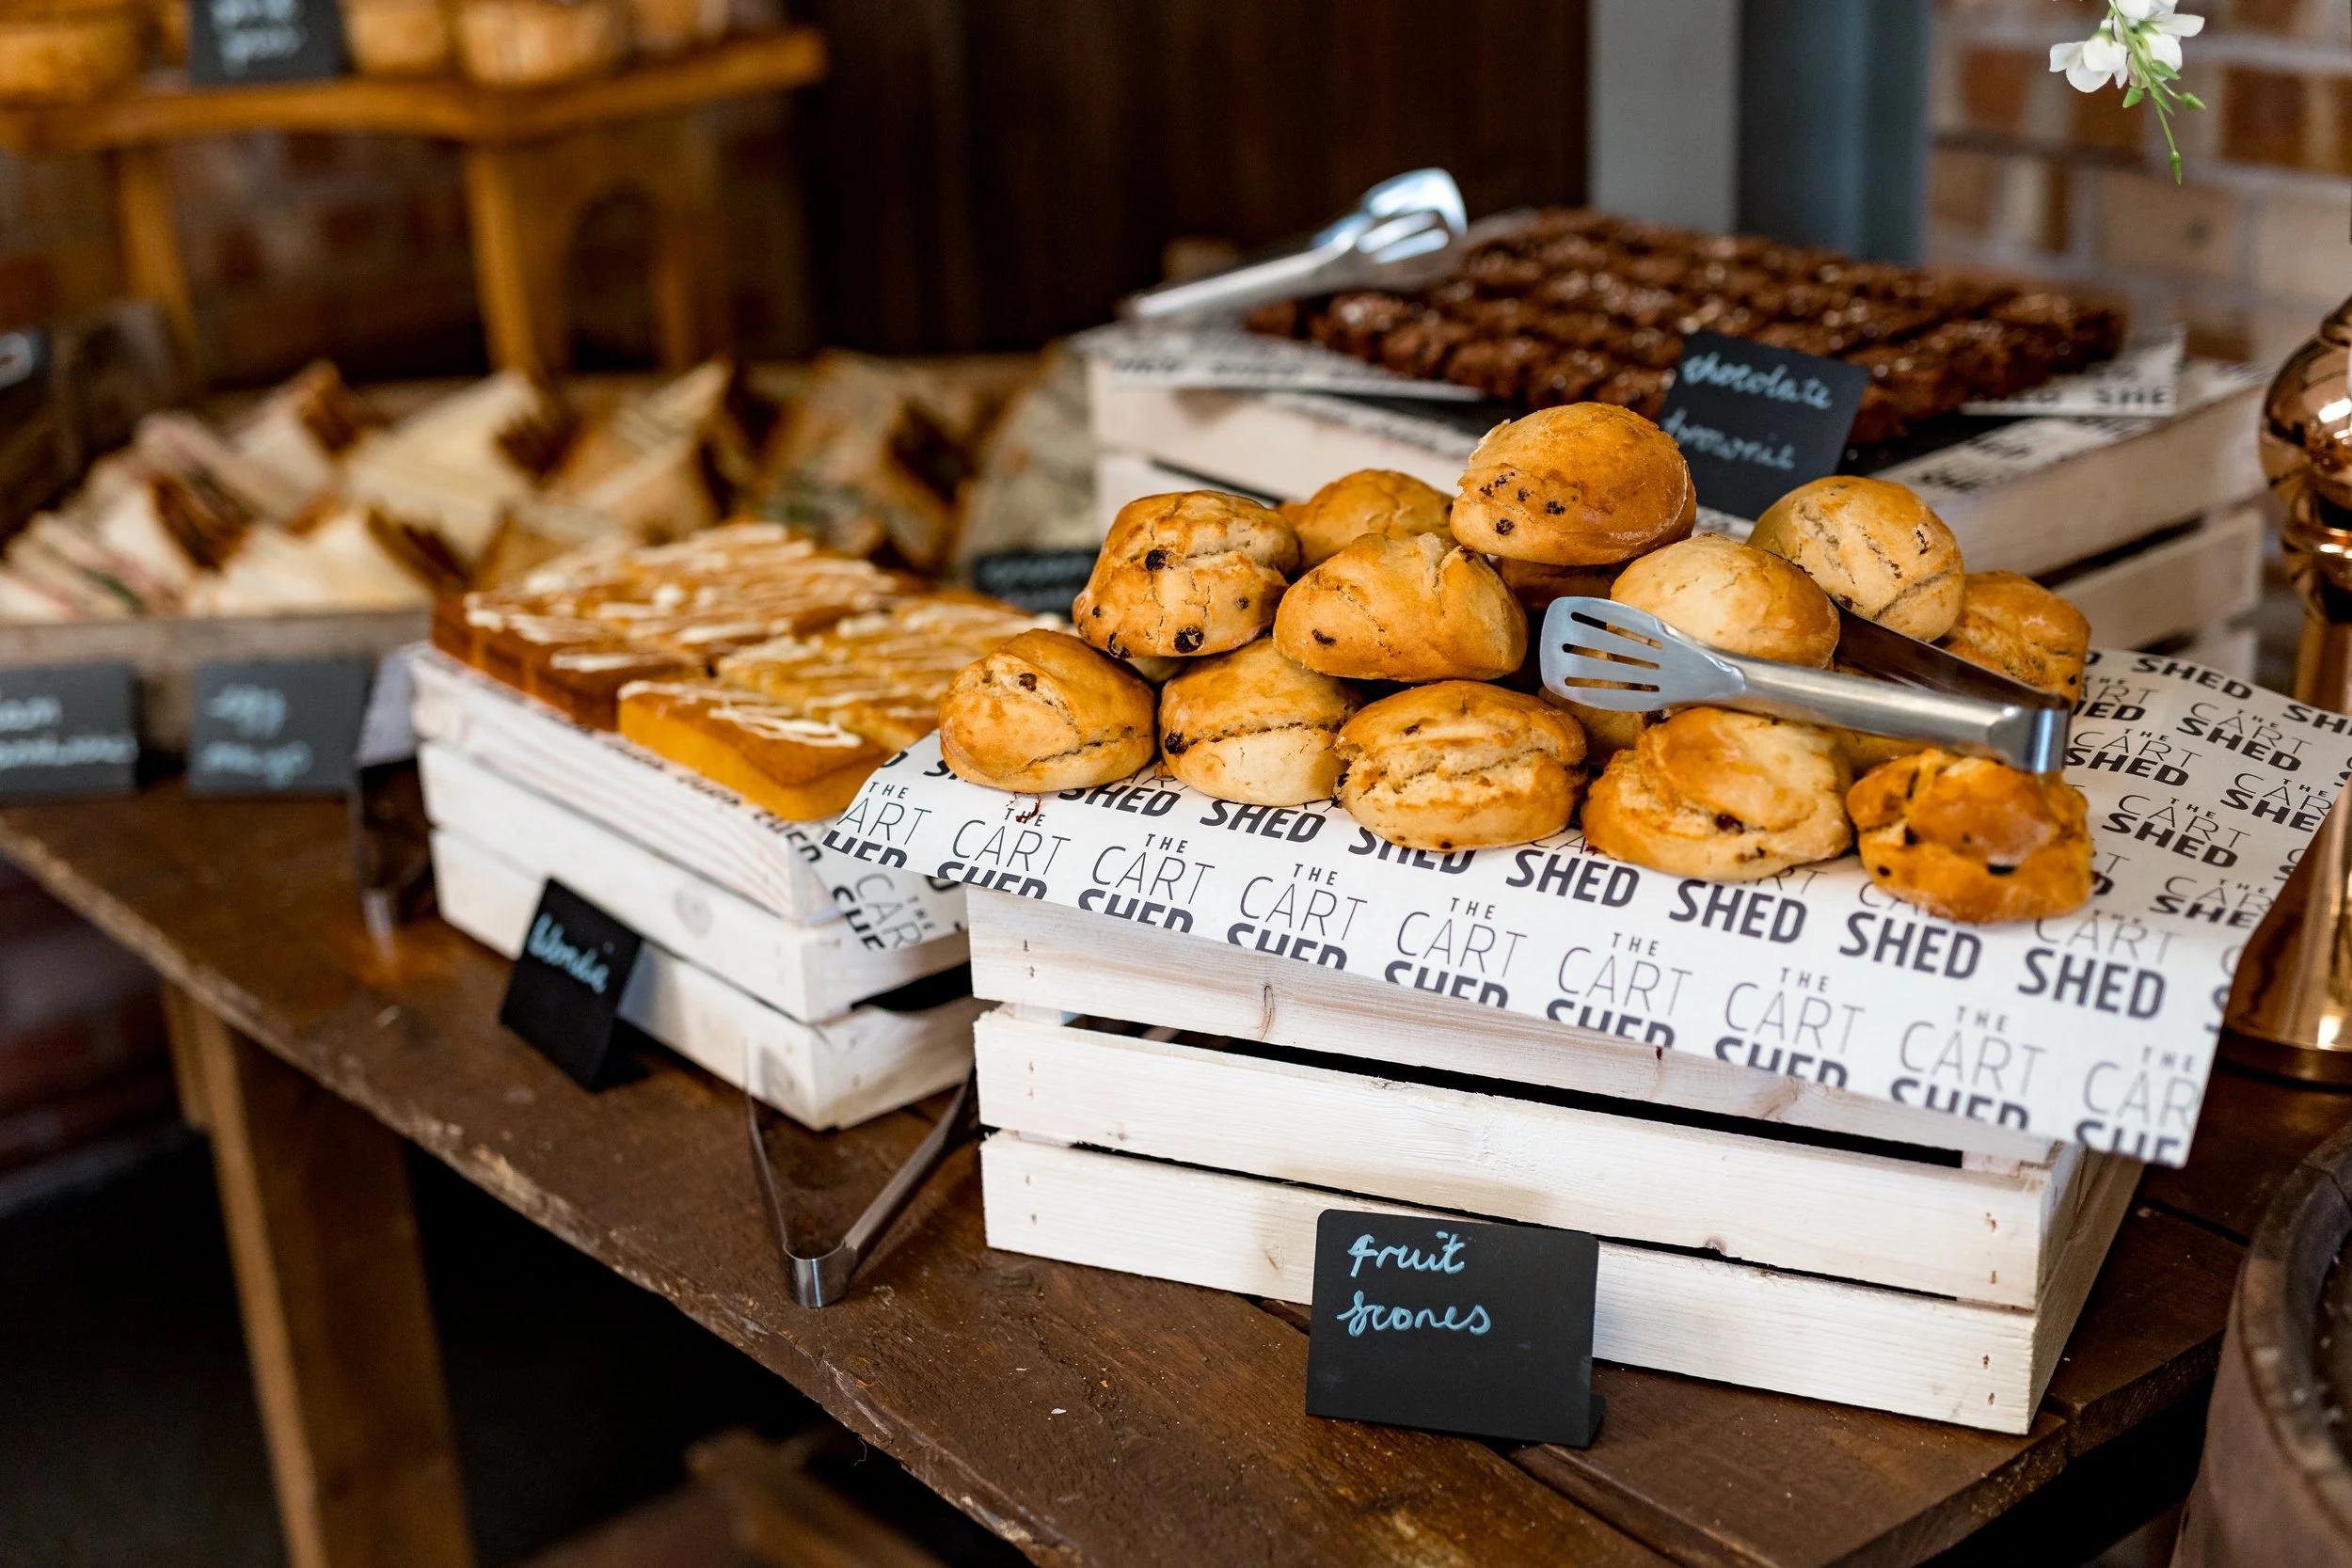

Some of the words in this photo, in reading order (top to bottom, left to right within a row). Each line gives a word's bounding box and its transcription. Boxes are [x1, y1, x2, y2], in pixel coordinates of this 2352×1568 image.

[2095, 387, 2168, 404] SHE
[2081, 684, 2160, 705] RT
[2131, 657, 2252, 700] SHED
[2072, 700, 2147, 721] ED
[2190, 702, 2313, 754] CART
[2237, 707, 2279, 729] THE
[2282, 704, 2352, 736] SH
[2074, 731, 2202, 768] CART
[2123, 728, 2169, 742] THE
[2175, 716, 2302, 772] SHED
[2064, 747, 2189, 786] SHED
[2282, 778, 2328, 798] THE
[869, 782, 910, 800] THE
[2169, 797, 2217, 819] THE
[2220, 788, 2321, 833] SHE
[2233, 772, 2333, 817] CAR
[836, 798, 932, 845] ART
[1145, 833, 1189, 854] THE
[1200, 800, 1327, 843] SHED
[2101, 813, 2238, 868] SHED
[2118, 794, 2251, 848] CART
[822, 830, 908, 868] HED
[952, 819, 1072, 875] CART
[1092, 846, 1216, 905] CART
[1293, 863, 1338, 886] THE
[1505, 848, 1641, 908] SHED
[2165, 876, 2274, 916] CAR
[832, 883, 886, 952] SHE
[855, 873, 923, 950] CAR
[1240, 876, 1368, 941] CART
[1450, 897, 1496, 920] THE
[1669, 879, 1807, 943] SHED
[2148, 895, 2259, 929] SHE
[1397, 911, 1528, 978] CART
[1611, 932, 1660, 958] THE
[1839, 911, 1983, 980] SHED
[1559, 947, 1693, 1017] CART
[1779, 967, 1831, 993] THE
[2017, 946, 2167, 1021] SHED
[1725, 982, 1867, 1055] CART
[1956, 1006, 2010, 1034] THE
[1899, 1021, 2047, 1097] CART
[2142, 1045, 2195, 1073] THE
[2083, 1060, 2202, 1128] CAR
[2074, 1118, 2184, 1166] SHE
[1346, 1230, 1468, 1278] fruit
[1336, 1290, 1492, 1338] scones
